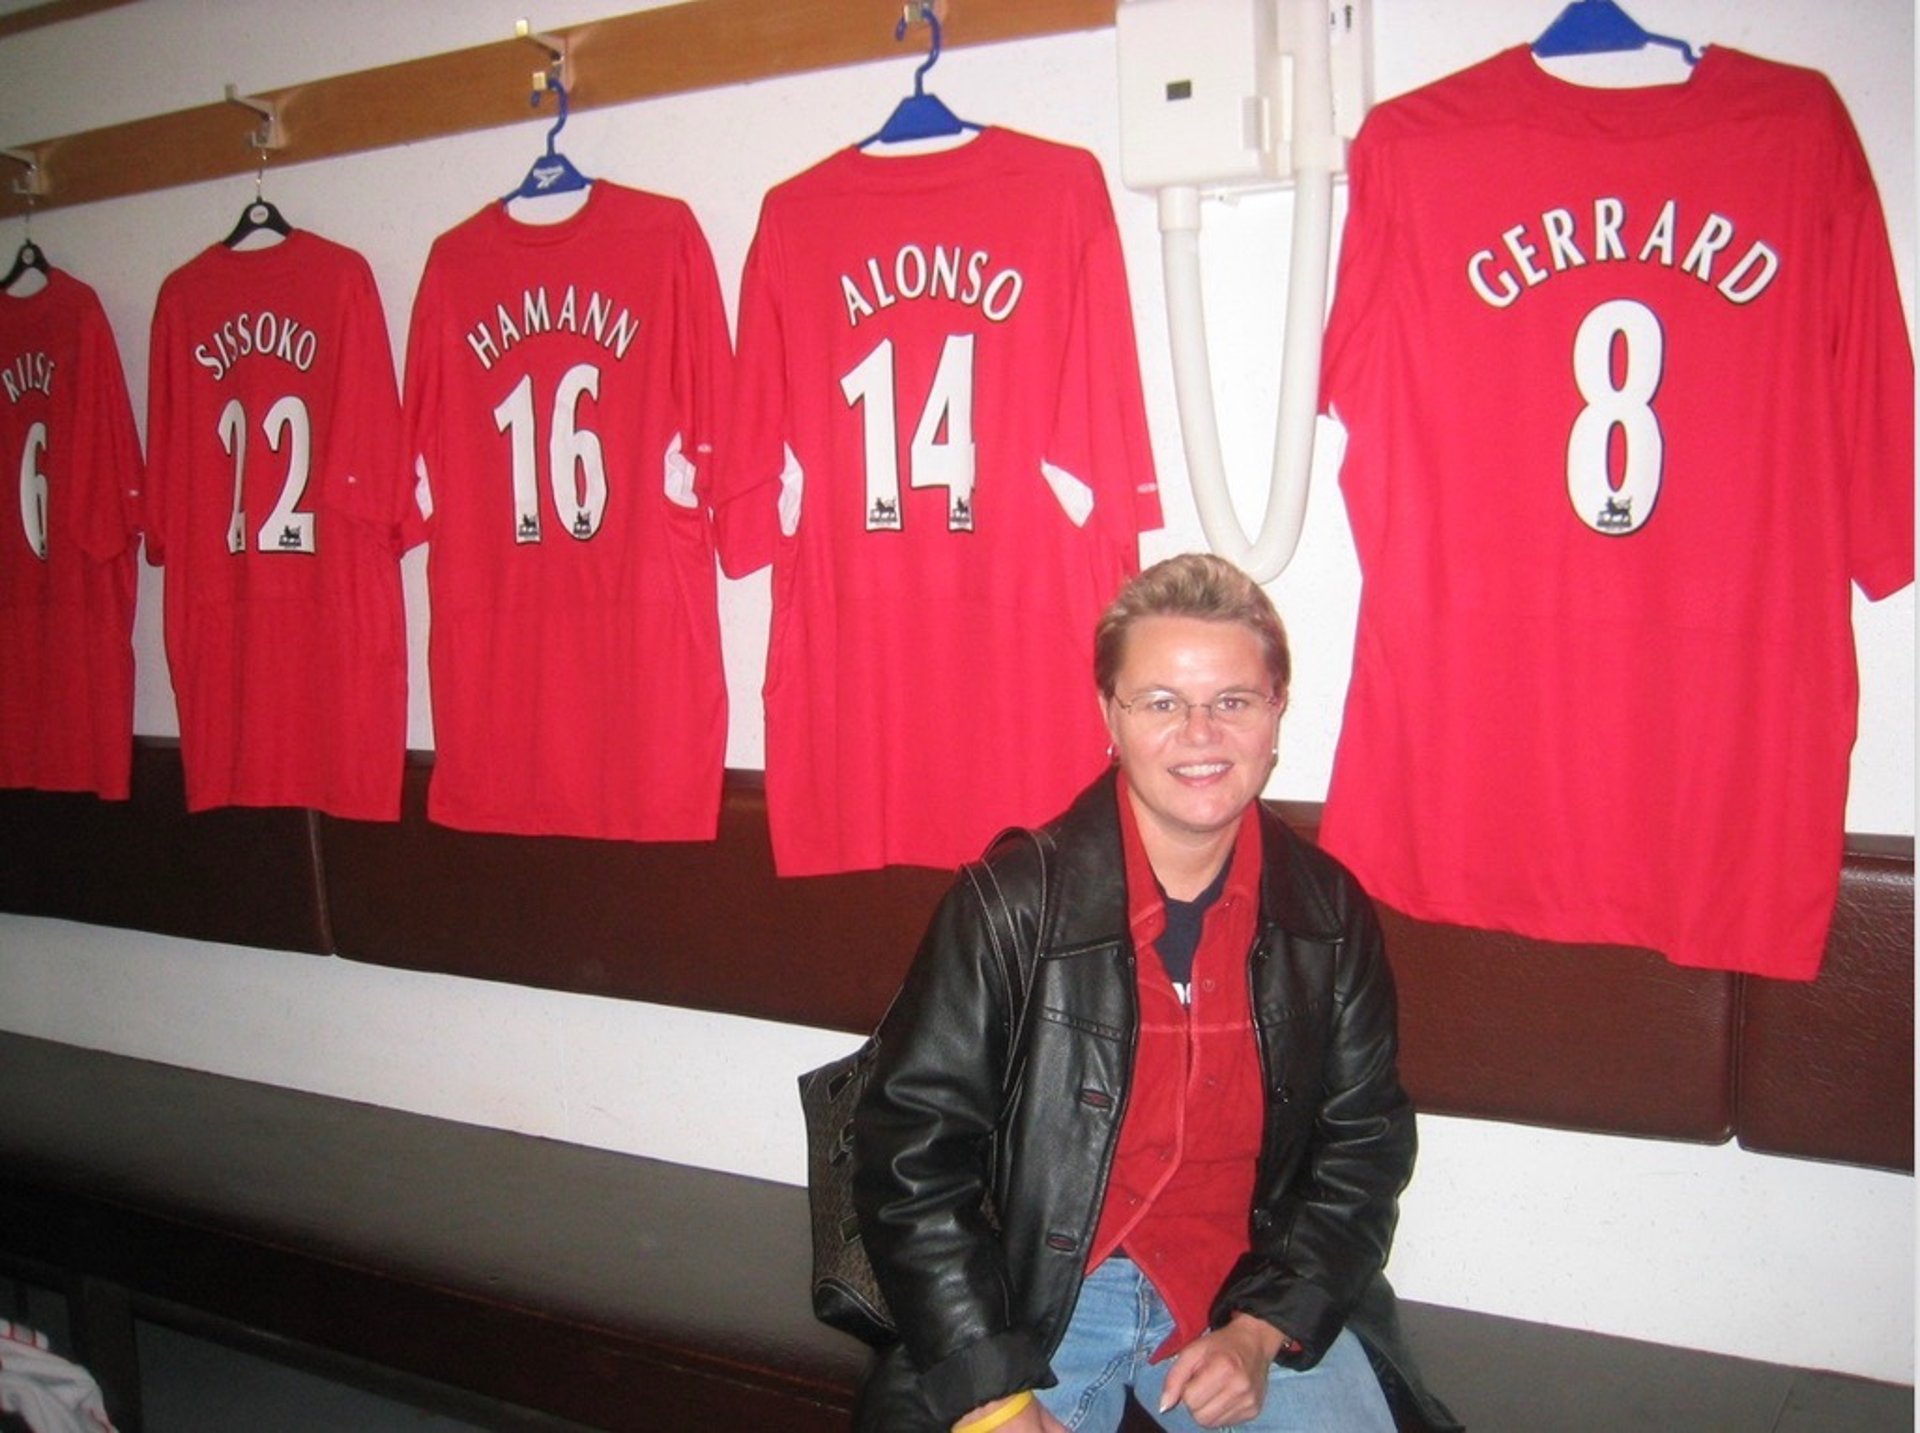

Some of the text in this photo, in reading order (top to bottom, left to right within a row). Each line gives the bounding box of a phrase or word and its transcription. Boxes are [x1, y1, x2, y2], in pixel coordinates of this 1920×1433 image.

[840, 244, 1024, 327] ALONSO
[1467, 196, 1780, 308] GERRARD
[195, 311, 317, 381] SISSOKO
[466, 284, 640, 371] HAMANN
[493, 362, 609, 544] 16
[839, 333, 976, 532] 14
[1565, 297, 1665, 536] 8
[20, 421, 48, 560] 6
